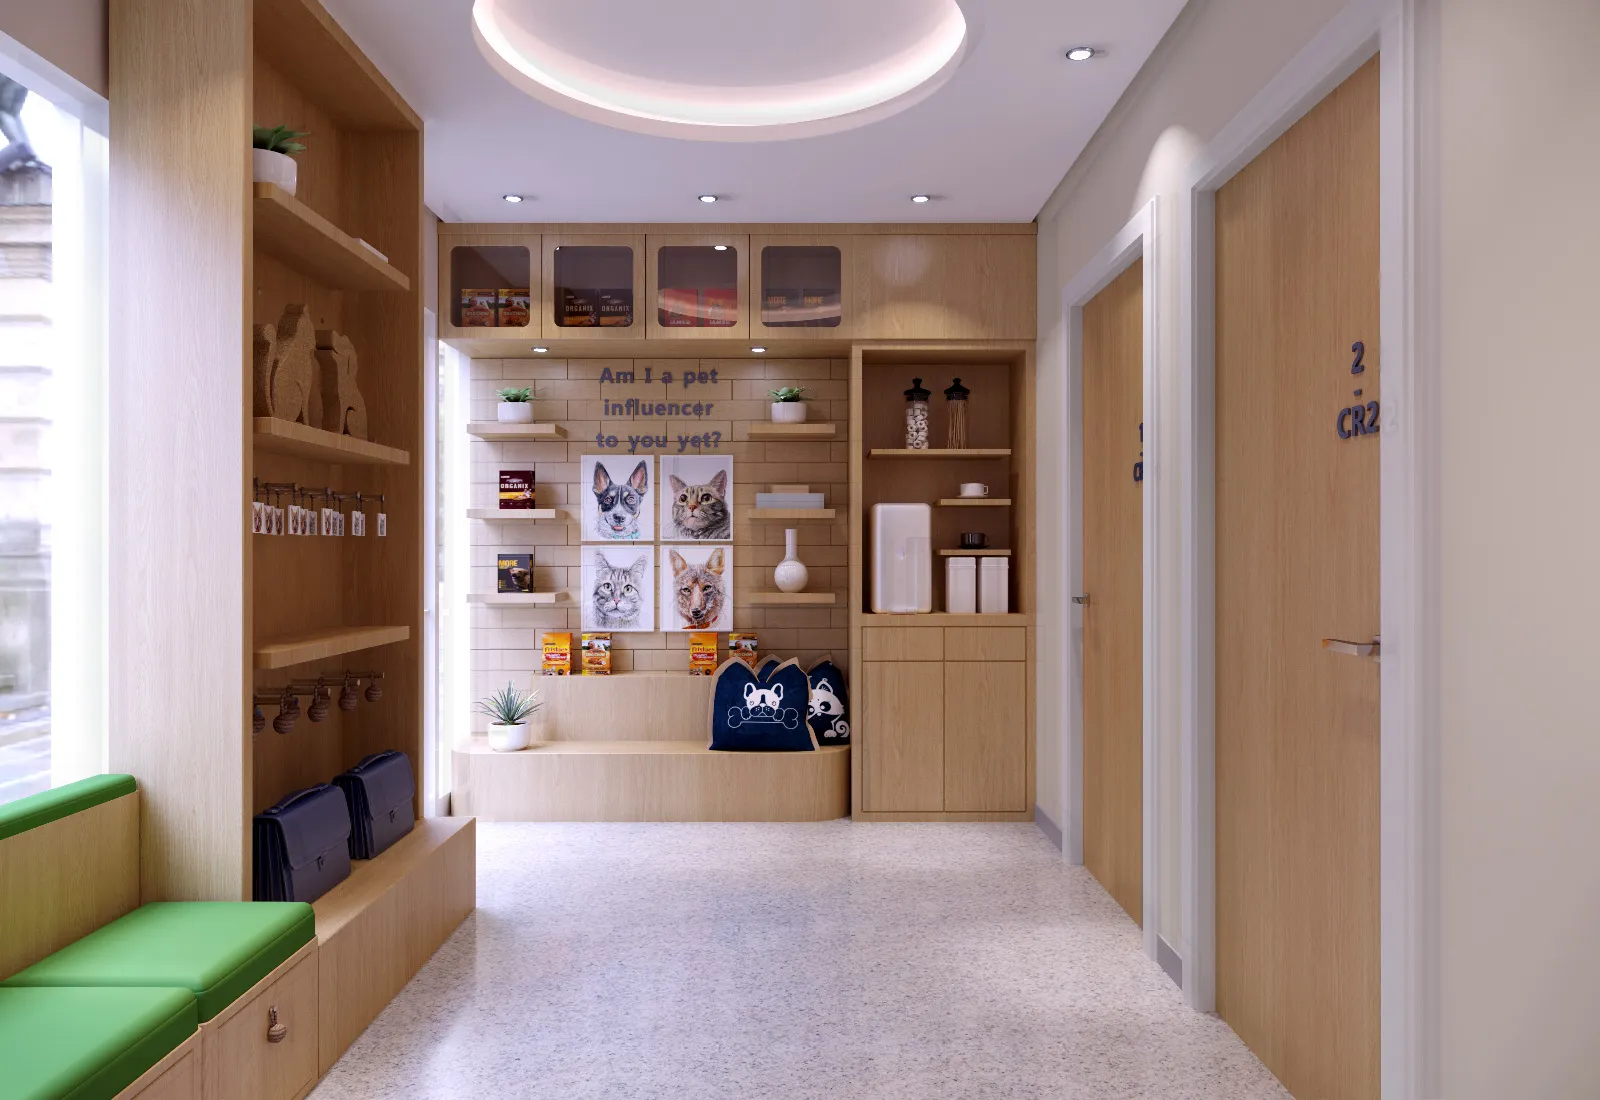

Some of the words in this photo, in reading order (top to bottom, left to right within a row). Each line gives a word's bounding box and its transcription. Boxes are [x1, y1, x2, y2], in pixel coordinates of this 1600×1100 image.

[1351, 341, 1365, 375] 2
[599, 367, 634, 384] Am
[644, 367, 652, 384] I
[661, 371, 673, 384] a
[683, 368, 719, 389] pet
[604, 398, 714, 416] influencer
[1337, 400, 1380, 440] CR2
[595, 433, 619, 448] to
[627, 435, 668, 453] you
[677, 431, 722, 453] yet?
[498, 559, 519, 567] MORE
